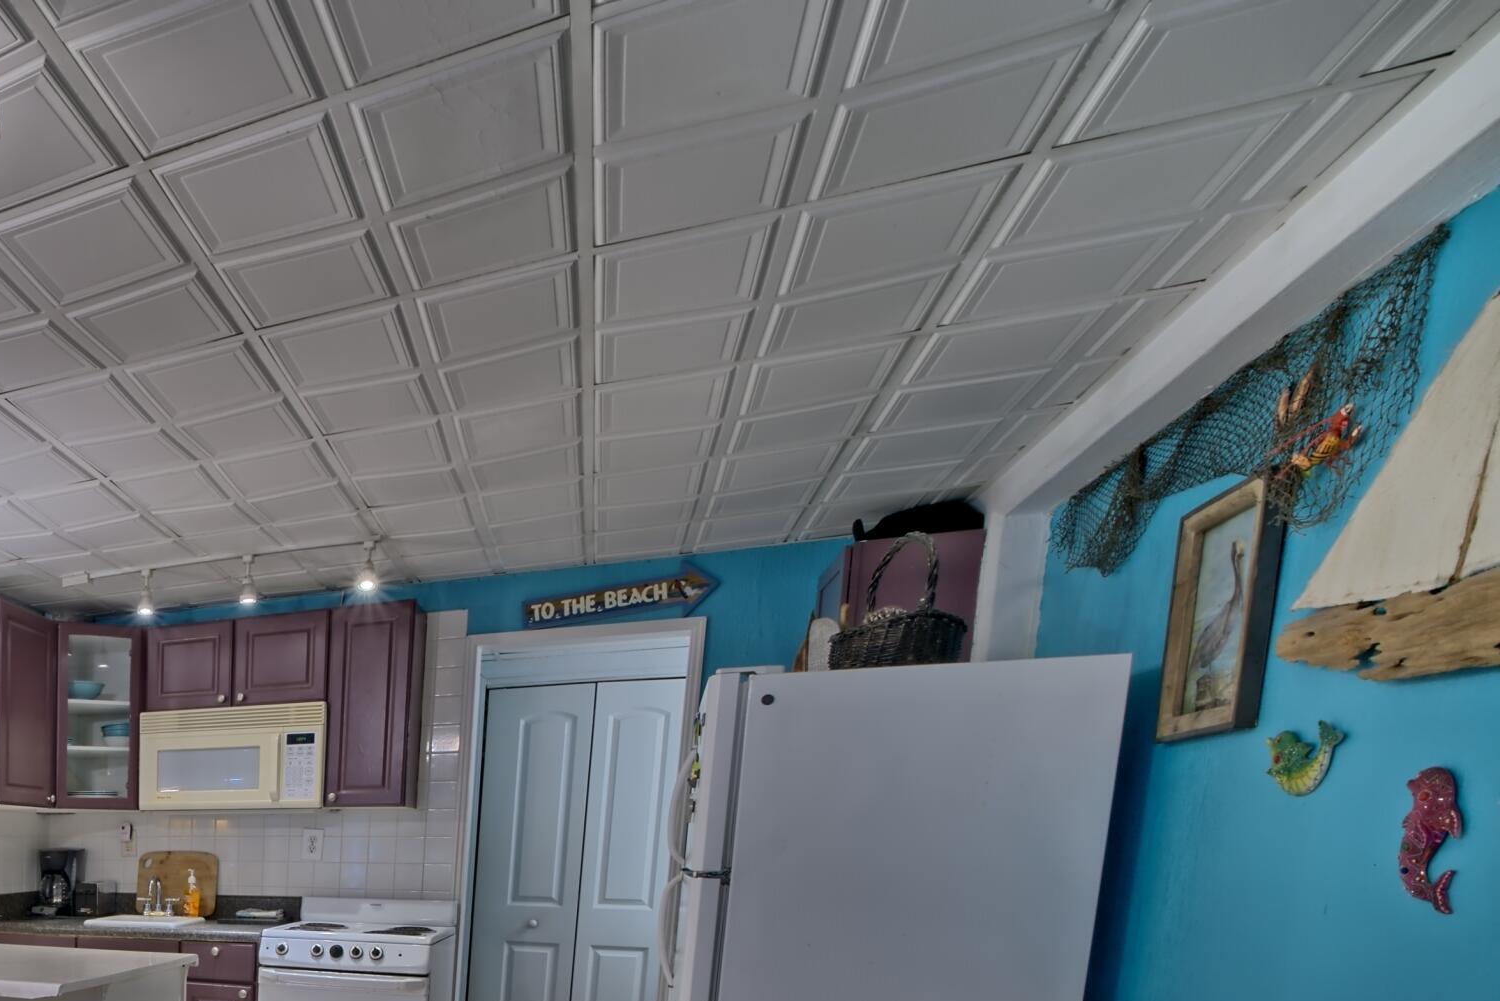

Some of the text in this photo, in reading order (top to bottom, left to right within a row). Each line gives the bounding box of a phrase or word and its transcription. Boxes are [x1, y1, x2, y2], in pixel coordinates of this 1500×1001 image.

[531, 582, 668, 622] TO THE BEACH
